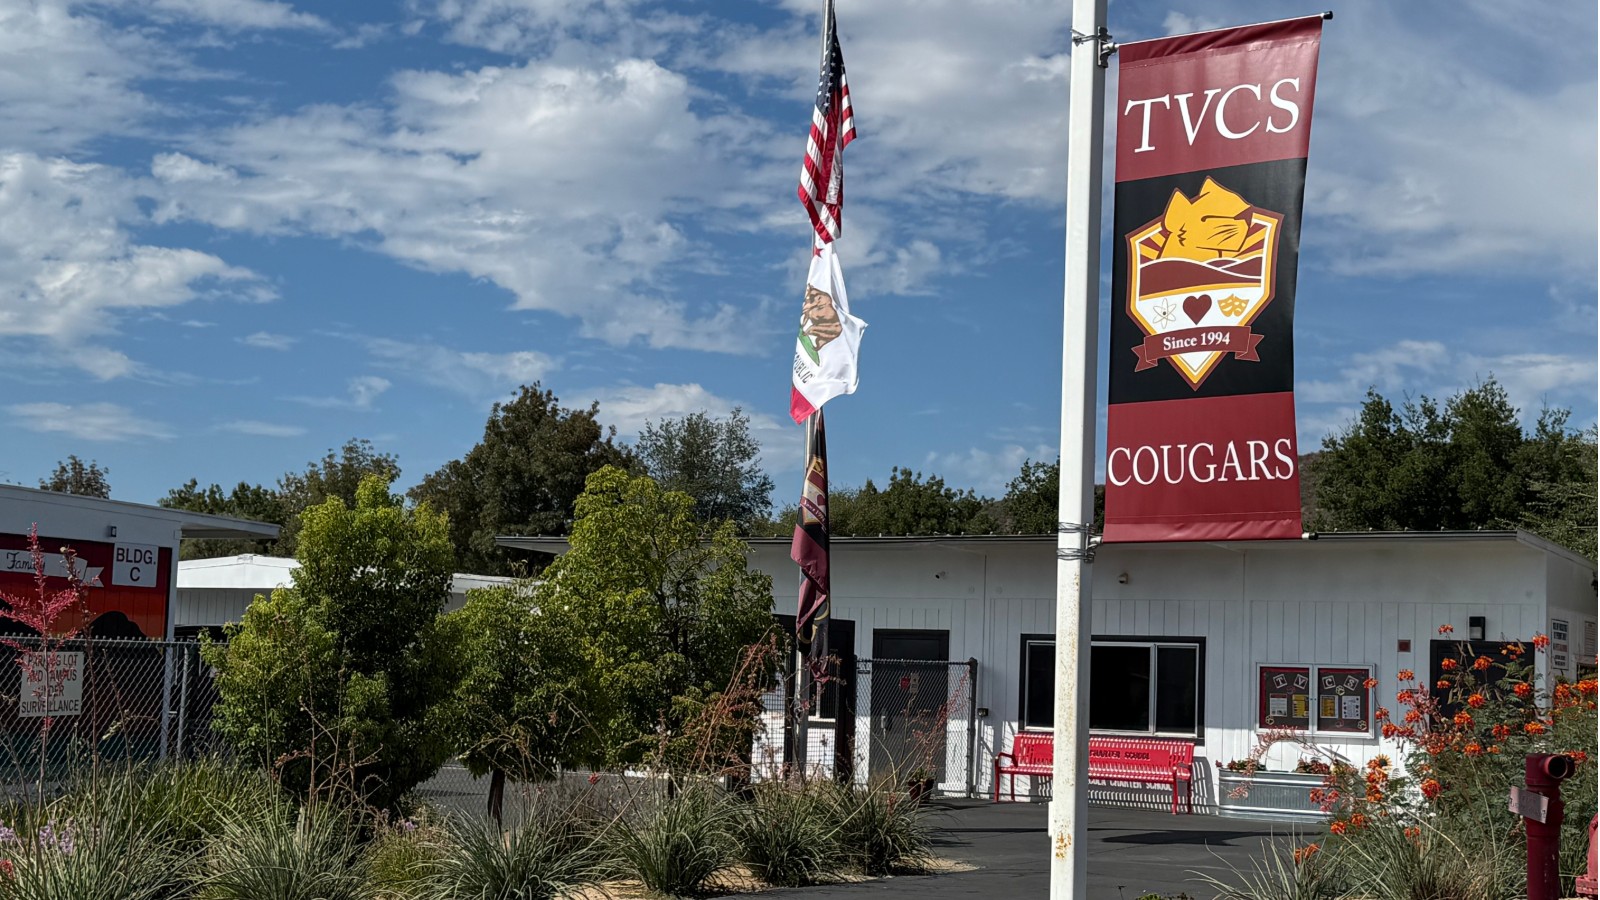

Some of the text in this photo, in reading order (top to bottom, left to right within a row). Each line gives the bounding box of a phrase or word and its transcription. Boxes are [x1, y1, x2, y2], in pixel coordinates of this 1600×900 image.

[1124, 77, 1300, 153] TVCS
[1163, 331, 1231, 351] Since 1994
[1107, 438, 1295, 487] COUGARS
[116, 547, 157, 565] BLDG.
[129, 566, 141, 582] C
[63, 654, 78, 667] LOT
[21, 699, 79, 713] SURVELLANCE
